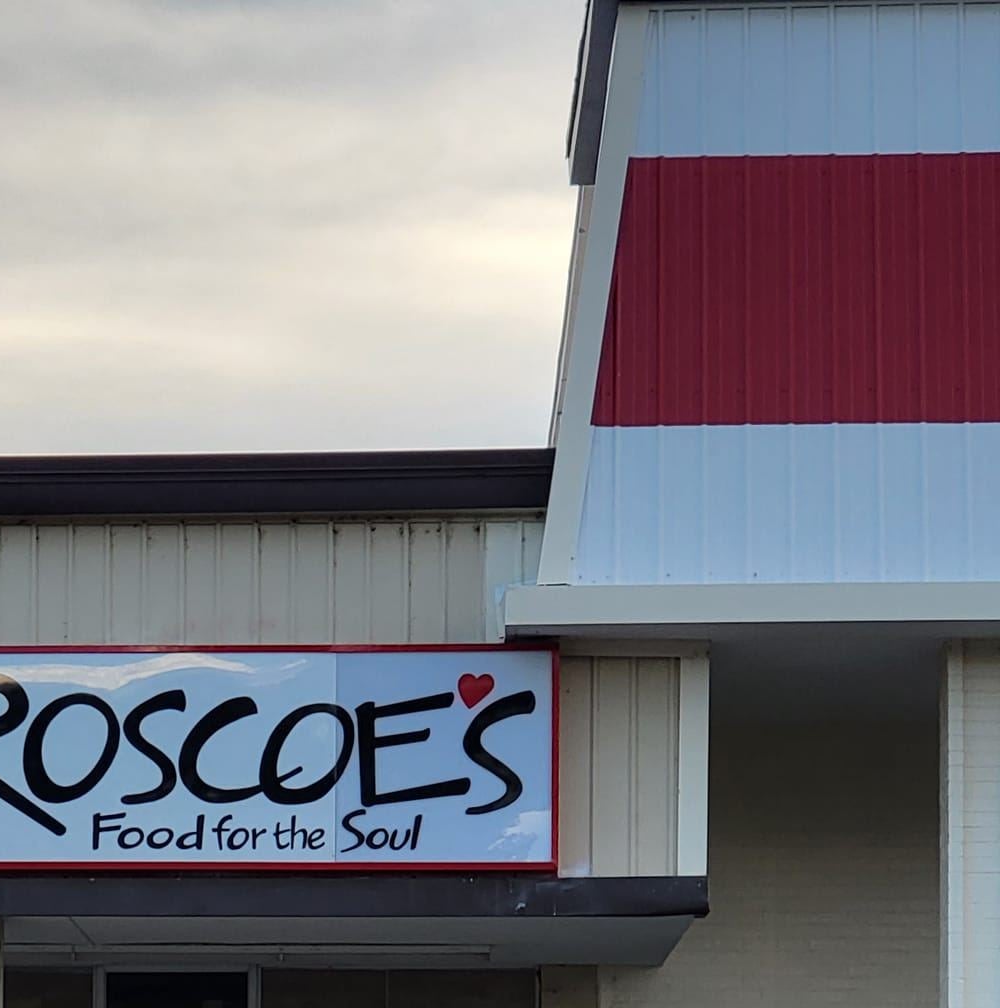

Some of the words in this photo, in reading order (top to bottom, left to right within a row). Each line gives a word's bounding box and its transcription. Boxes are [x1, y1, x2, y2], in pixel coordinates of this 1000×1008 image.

[91, 811, 204, 851] Food
[212, 814, 260, 851] for
[273, 815, 326, 851] the
[340, 808, 423, 852] Soul
